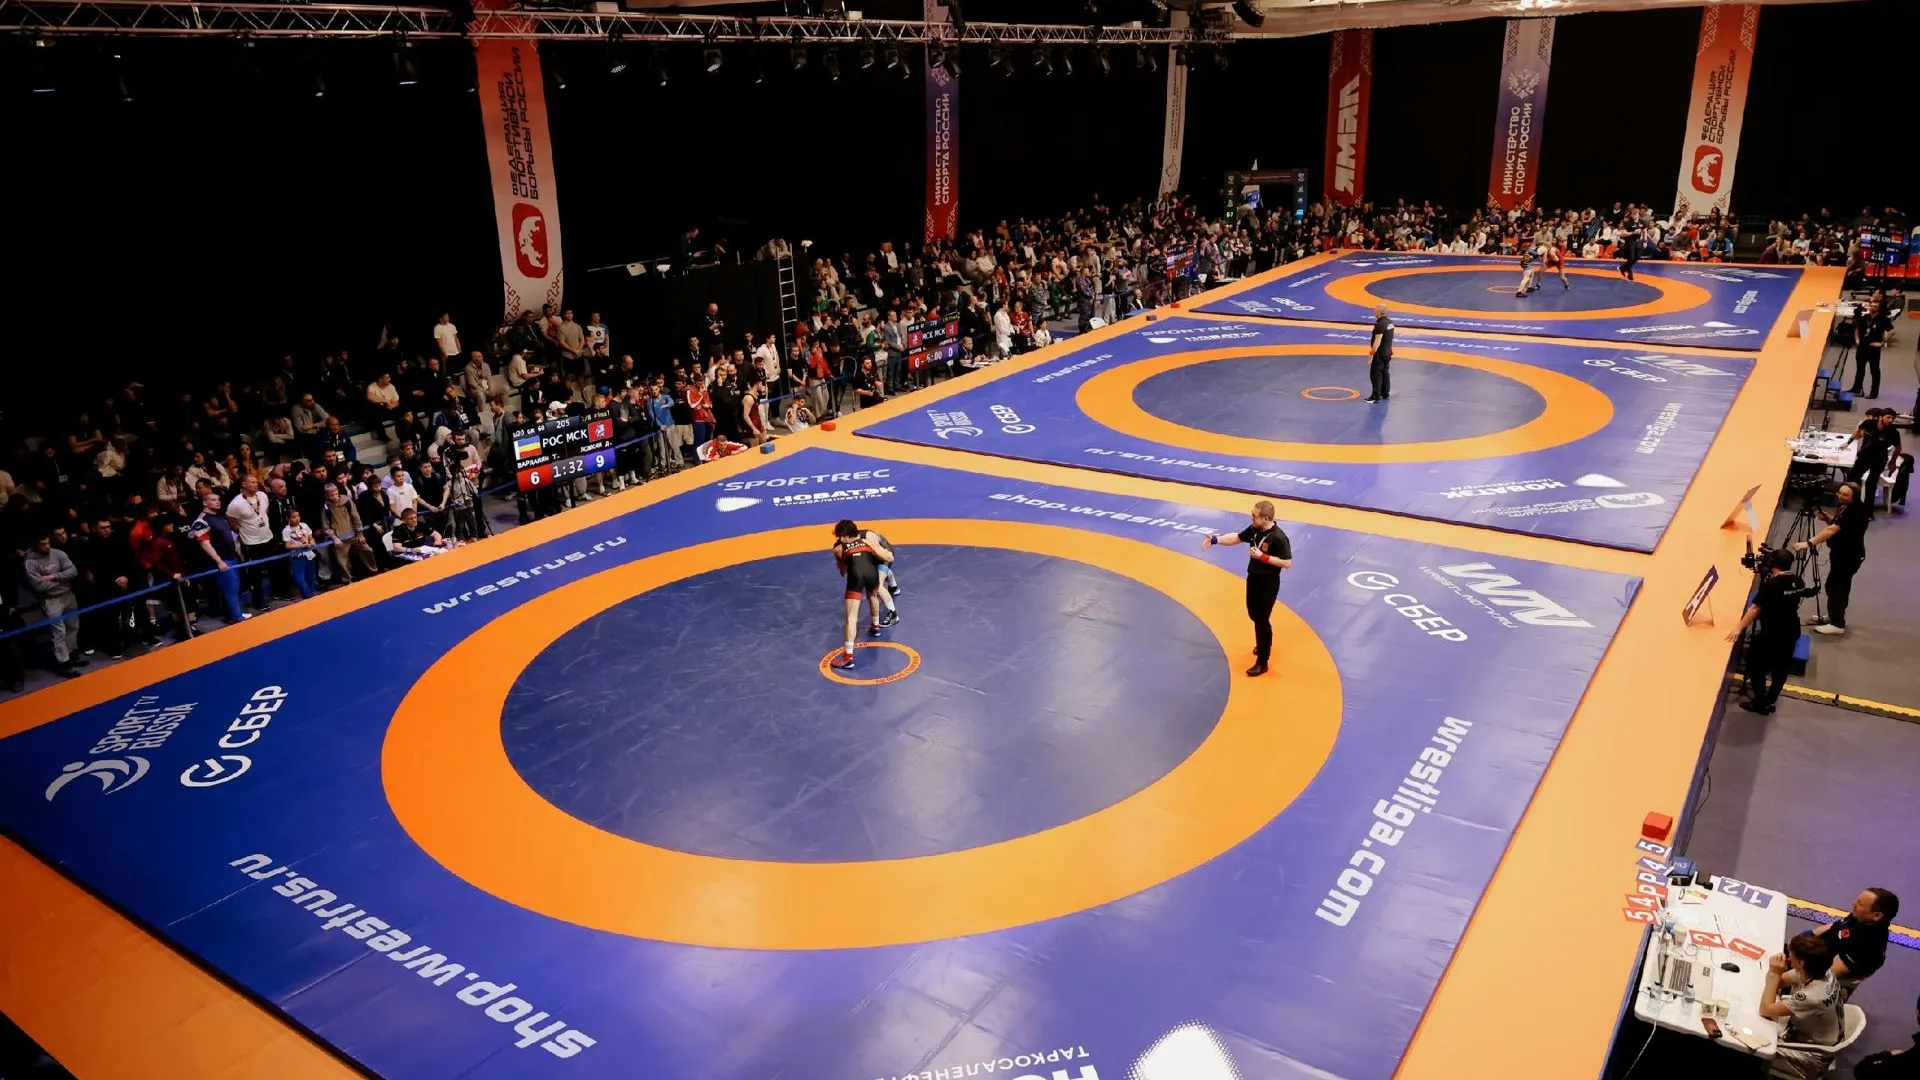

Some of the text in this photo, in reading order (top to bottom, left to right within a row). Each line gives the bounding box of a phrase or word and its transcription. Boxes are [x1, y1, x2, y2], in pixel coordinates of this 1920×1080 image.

[1701, 70, 1718, 141] ФЕДЕРАЦИЯ
[1708, 64, 1727, 143] СПОРТИВНОЙ
[1716, 49, 1737, 144] БОРЬБЫ РОССИИ
[503, 72, 528, 198] СПОРТИВНОЙ
[511, 47, 539, 200] БОРЬБЫ РОССИИ
[497, 81, 519, 195] ФЕДЕРАЦИЯ
[941, 93, 950, 204] СПОРТА РОССИИ
[1514, 102, 1533, 195] СПОРТА РОССИИ
[1502, 106, 1520, 195] МИНИСТЕРСТВО
[914, 357, 920, 368] 0
[948, 347, 953, 358] 0
[1032, 353, 1115, 384] wrestrus.ru
[1609, 366, 1668, 383] СБЕР
[556, 419, 570, 429] 205
[989, 404, 1022, 424] СБЕР
[542, 428, 588, 448] РОС МСК
[1634, 402, 1684, 455] wrestliga.com
[552, 459, 584, 478] 1:32
[595, 455, 605, 468] 9
[1083, 448, 1338, 487] shop.wrestrus.ru
[530, 471, 540, 485] 6
[723, 468, 891, 492] SPORTREC
[1440, 480, 1568, 499] НОВАТЭК
[772, 485, 898, 504] НОВАТЭК
[421, 536, 628, 615] wrestrus.ru
[1383, 593, 1469, 642] СБЕР
[128, 702, 199, 751] RUSSIA
[218, 685, 289, 749] СБЕР
[88, 708, 160, 755] SPORT
[1315, 716, 1473, 927] wrestliga.com
[1638, 840, 1665, 854] 5
[1642, 857, 1668, 871] 4
[1723, 881, 1742, 894] 2
[1749, 891, 1763, 904] 1
[1628, 895, 1655, 907] 4
[1624, 909, 1653, 923] 5
[1693, 933, 1721, 946] 2
[1734, 941, 1761, 956] 1
[227, 853, 598, 1059] shop.wrestrus.ru
